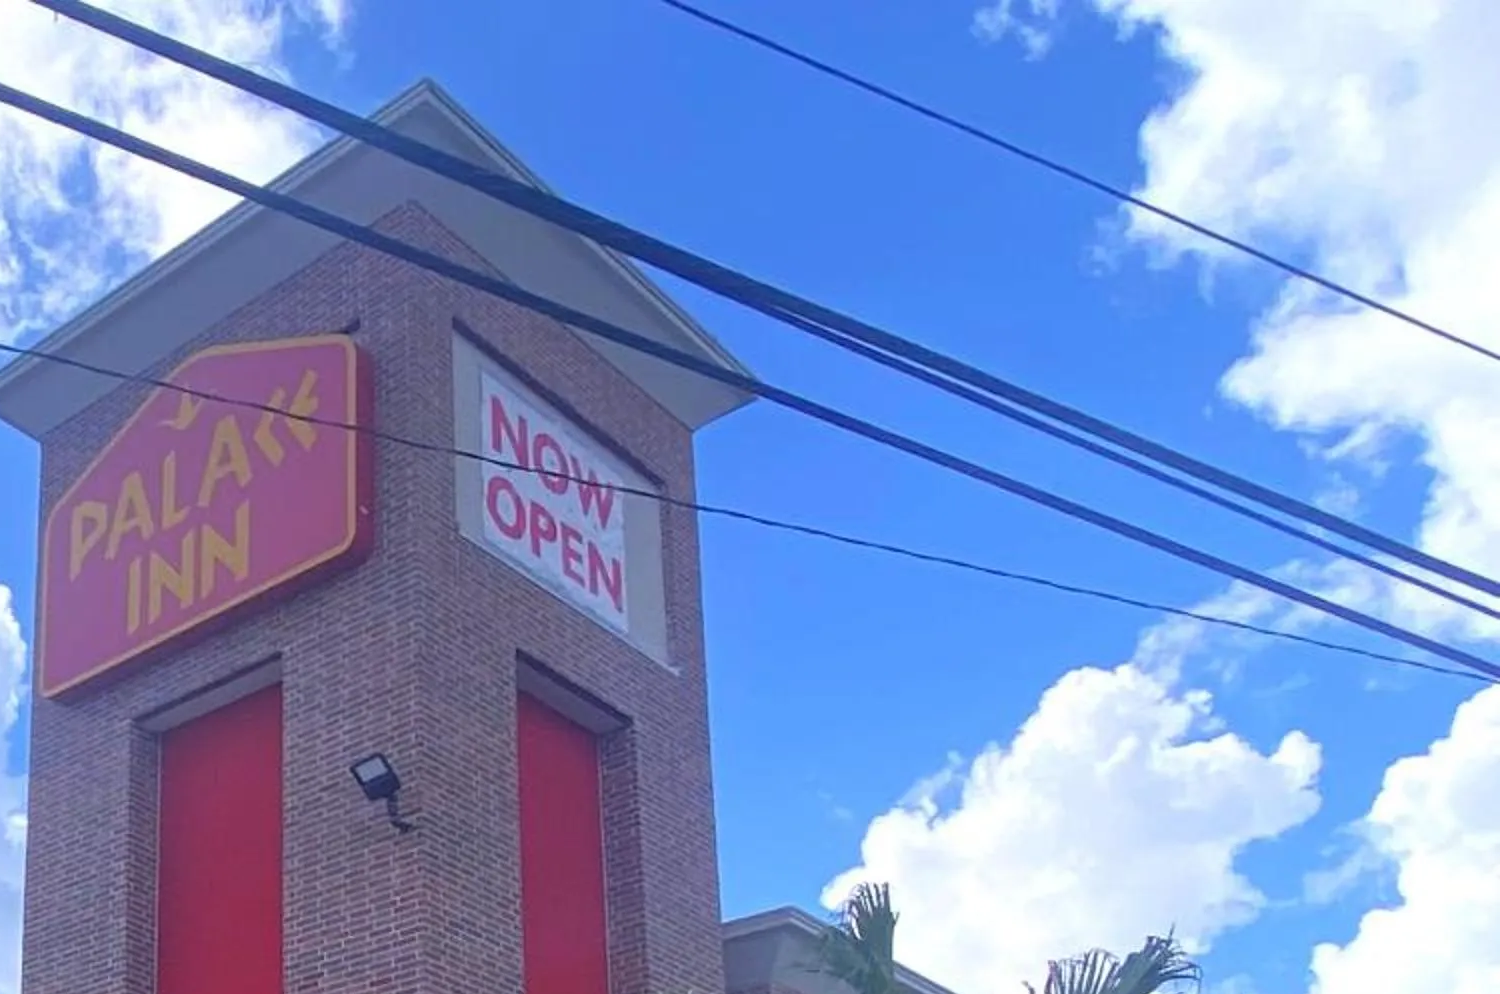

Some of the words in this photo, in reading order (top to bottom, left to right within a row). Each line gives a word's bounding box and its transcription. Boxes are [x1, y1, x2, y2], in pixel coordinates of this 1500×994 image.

[490, 394, 616, 530] NOW
[127, 499, 249, 636] INN
[486, 476, 623, 613] OPEN
